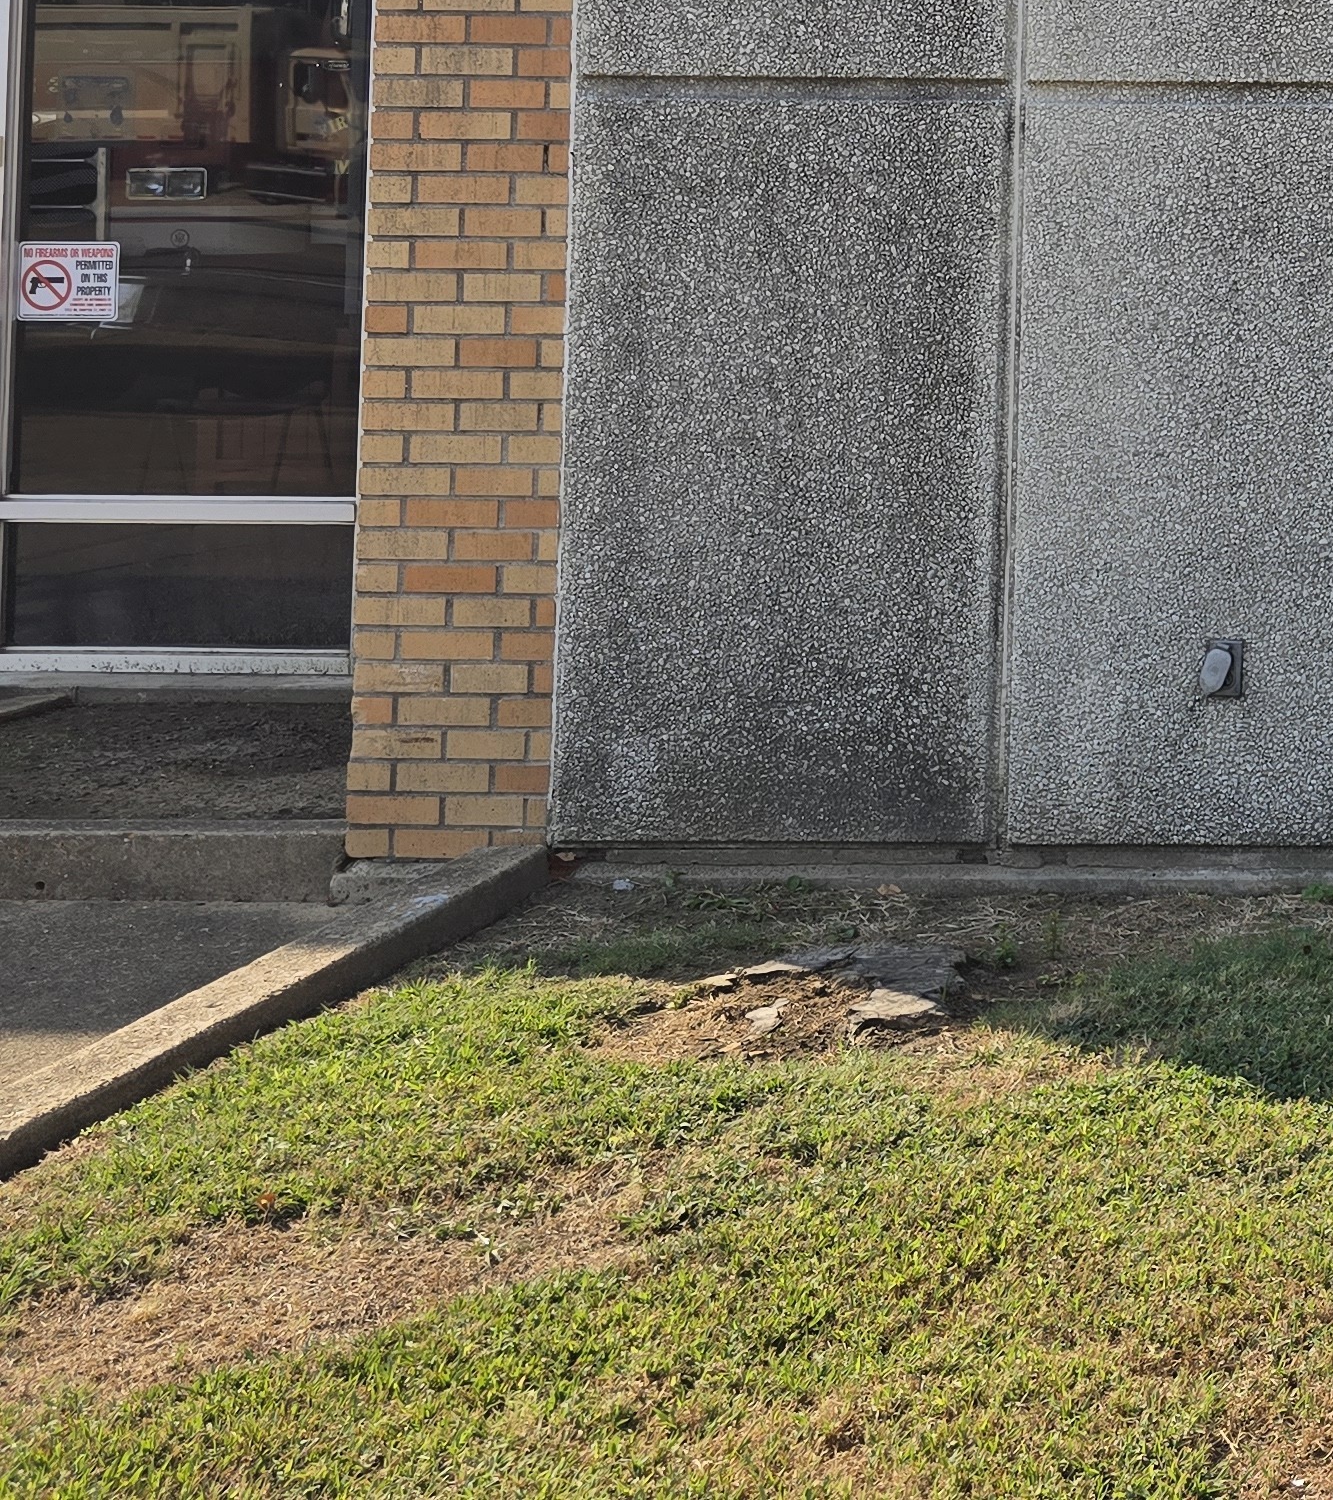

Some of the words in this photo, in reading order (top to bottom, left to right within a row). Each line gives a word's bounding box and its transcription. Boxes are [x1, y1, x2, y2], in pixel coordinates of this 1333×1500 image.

[24, 248, 33, 257] NO
[35, 248, 68, 257] FIREARMS
[70, 248, 79, 257] OR
[81, 248, 114, 257] WEAPONS
[75, 260, 113, 270] PERMITTED
[81, 273, 90, 283] ON
[93, 273, 107, 283] THIS
[76, 286, 111, 295] PROPERTY
